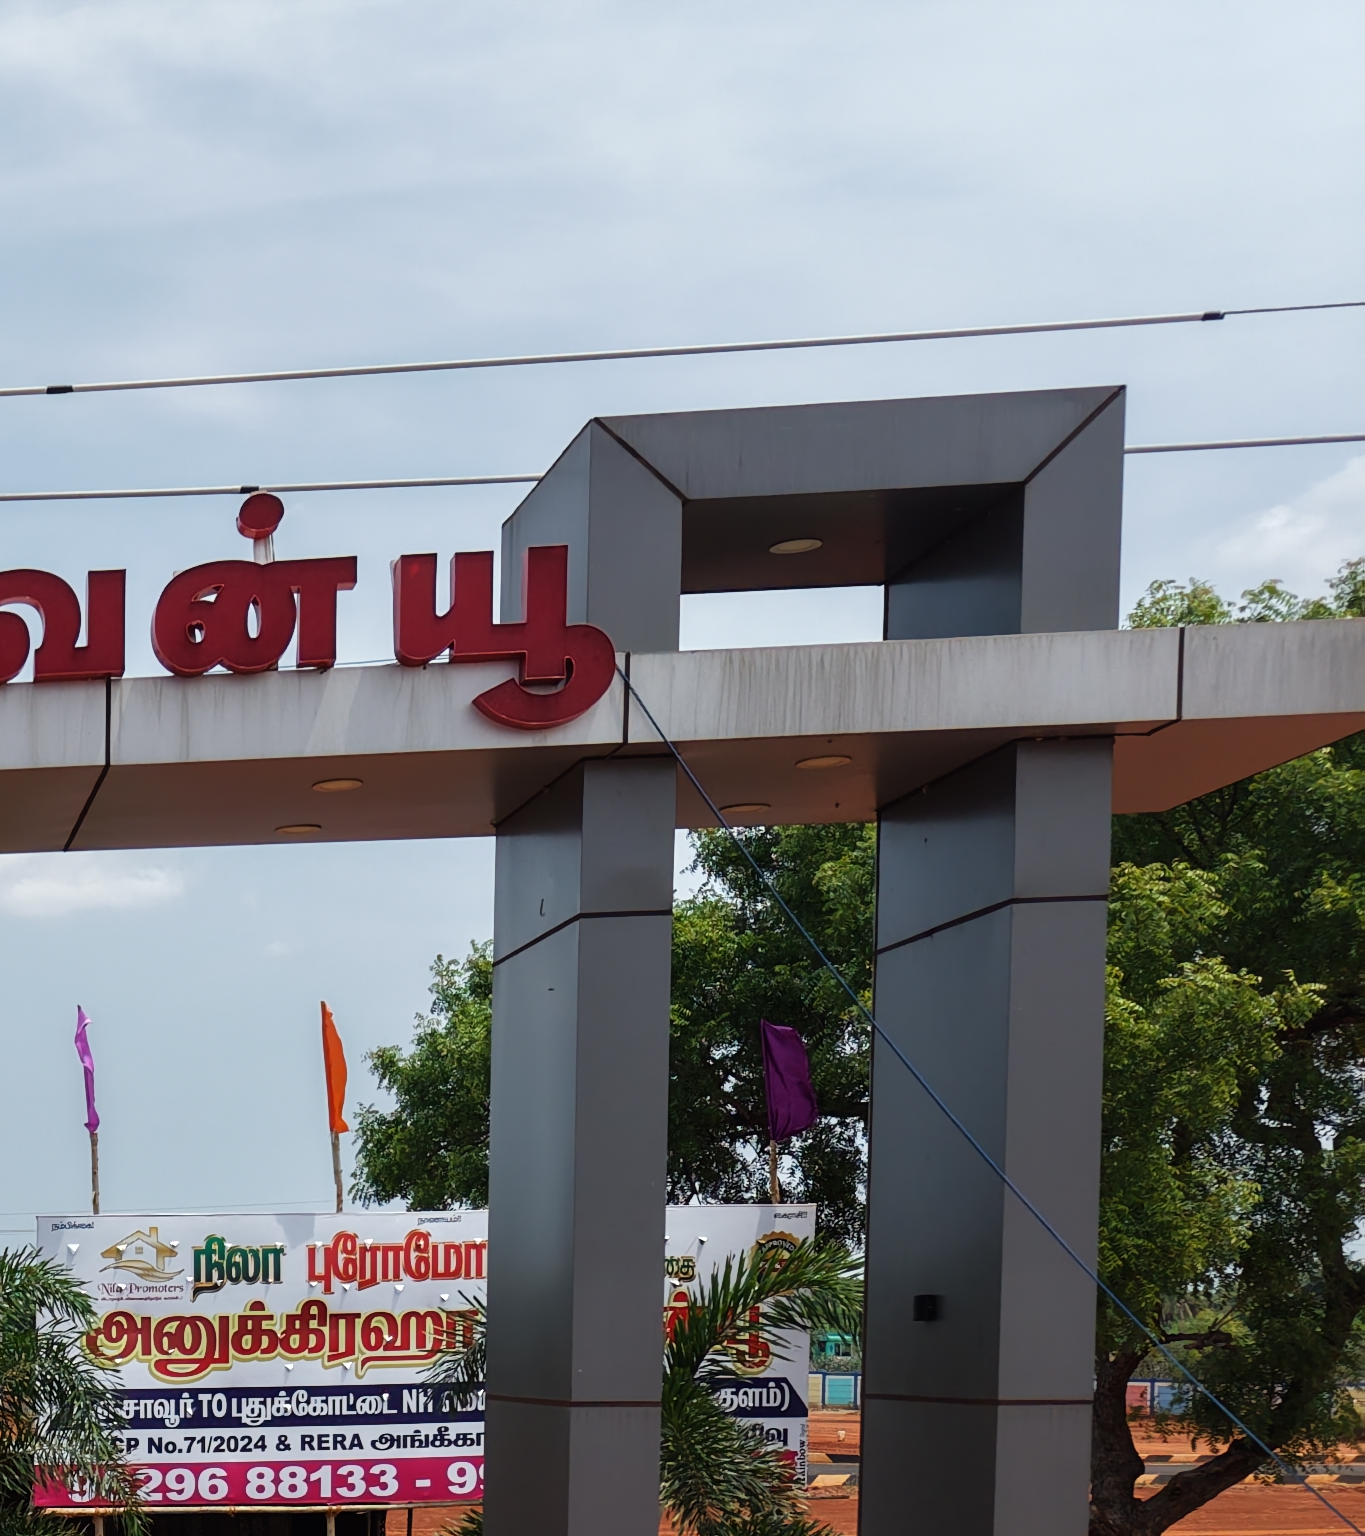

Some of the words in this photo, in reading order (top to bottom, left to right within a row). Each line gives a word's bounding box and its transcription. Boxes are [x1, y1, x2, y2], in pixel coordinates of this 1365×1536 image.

[191, 1234, 287, 1302] நிலா
[124, 1282, 184, 1298] Promoters
[198, 1393, 227, 1418] TO
[147, 1435, 267, 1454] No.71/2024
[276, 1434, 291, 1451] &
[300, 1433, 364, 1451] RERA
[68, 1467, 228, 1503] 9296
[245, 1463, 399, 1500] 88133
[447, 1461, 485, 1494] 9
